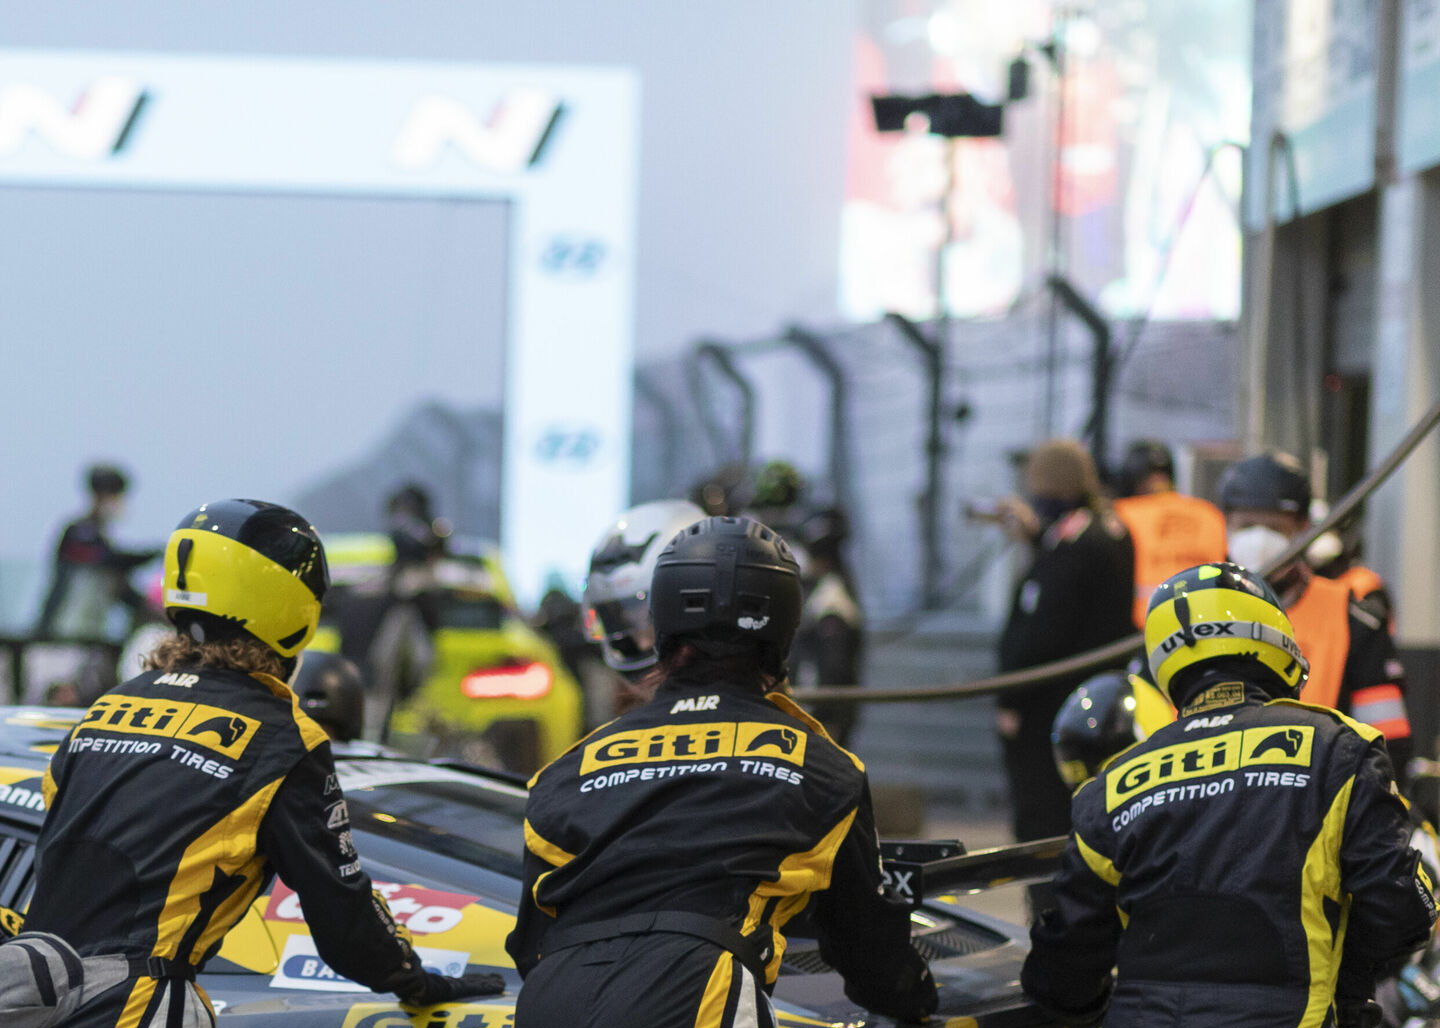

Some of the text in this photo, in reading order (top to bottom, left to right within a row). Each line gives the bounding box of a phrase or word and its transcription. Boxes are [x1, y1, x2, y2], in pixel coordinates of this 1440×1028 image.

[170, 744, 235, 780] TIRES
[594, 730, 721, 762] Giti
[579, 759, 804, 793] COMPETITION TIRES
[1116, 741, 1228, 795] Giti
[1111, 771, 1311, 833] COMPETITION TIRES
